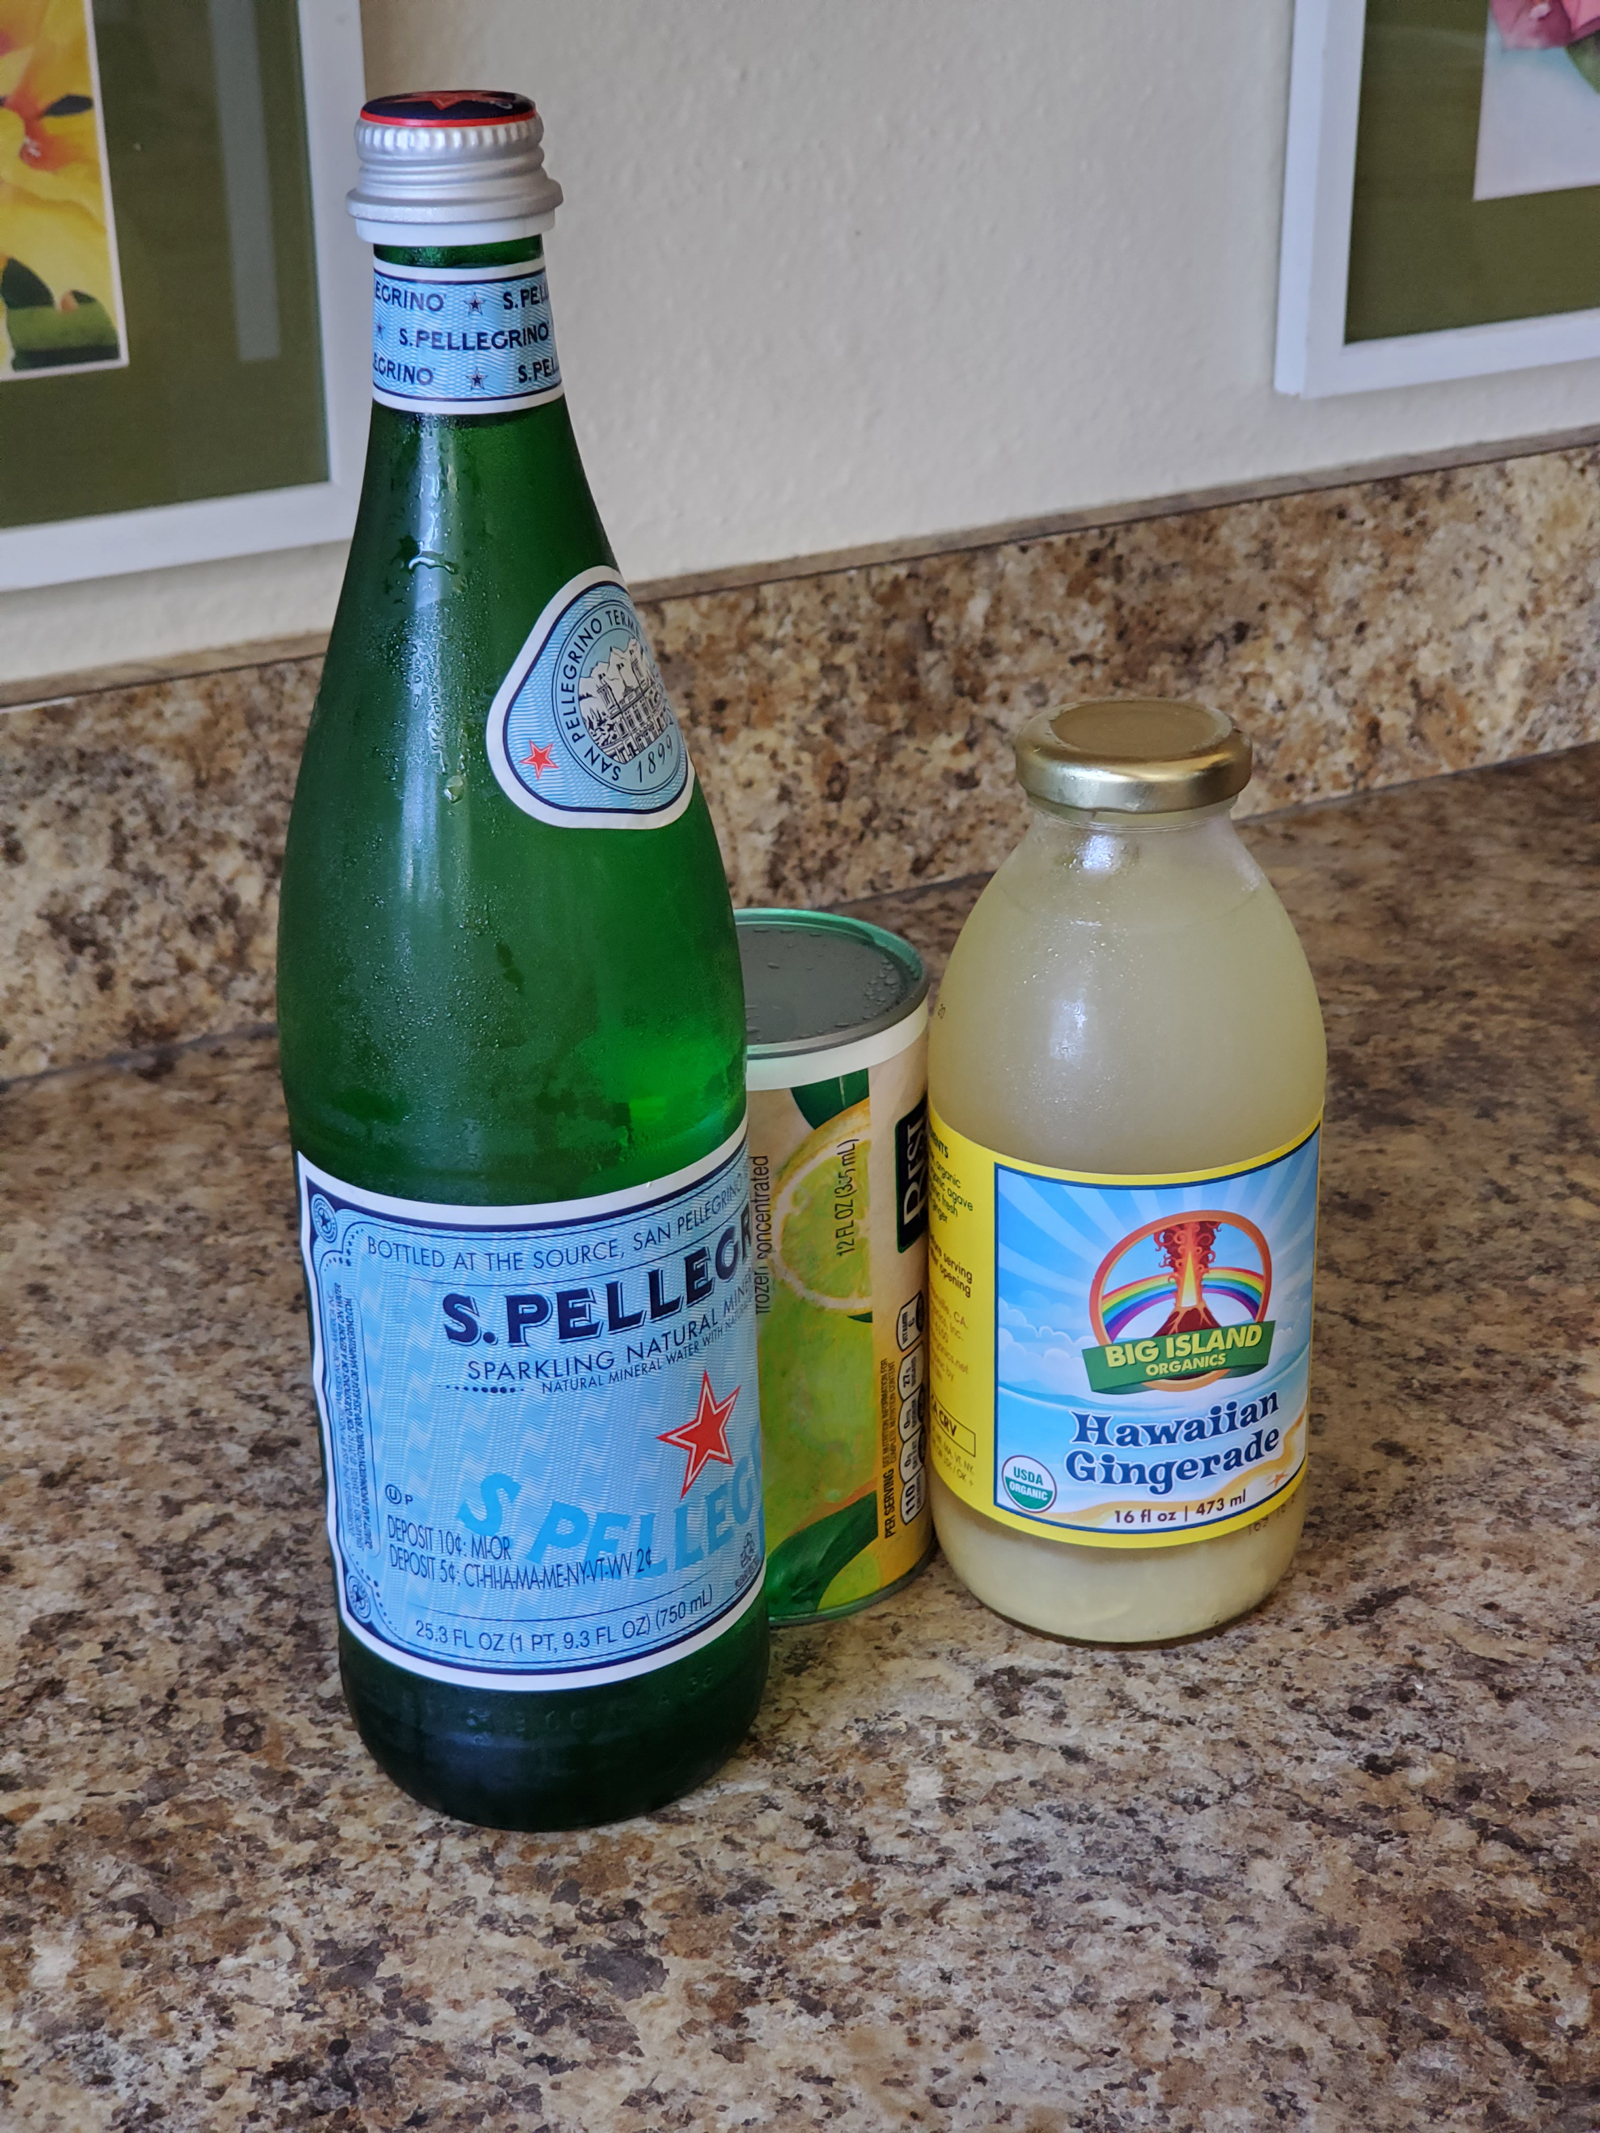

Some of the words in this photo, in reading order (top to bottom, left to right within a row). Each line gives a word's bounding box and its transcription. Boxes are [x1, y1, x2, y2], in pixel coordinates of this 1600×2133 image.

[399, 321, 550, 351] S.PELLEGRINO
[560, 616, 603, 745] PELLEGRINO
[582, 744, 622, 782] SAN
[636, 733, 674, 784] 1899
[836, 1138, 860, 1167] mL)
[750, 1154, 773, 1261] concentrated
[834, 1199, 854, 1220] OZ
[946, 1187, 974, 1212] agave
[367, 1235, 445, 1268] BOTTLED
[453, 1251, 477, 1271] AT
[484, 1251, 525, 1272] THE
[533, 1238, 625, 1270] SOURCE,
[633, 1221, 672, 1252] SAN
[835, 1220, 854, 1239] FL
[836, 1238, 855, 1257] 12
[939, 1263, 971, 1299] opening
[942, 1252, 973, 1285] serving
[467, 1350, 615, 1381] SPARKLING
[627, 1307, 719, 1364] NATURAL
[1104, 1339, 1160, 1369] BIG
[1165, 1323, 1264, 1360] ISLAND
[541, 1374, 604, 1395] NATURAL
[608, 1357, 662, 1385] MINERAL
[665, 1341, 699, 1365] WATER
[1145, 1352, 1227, 1377] ORGANICS
[938, 1408, 958, 1437] CRV
[1069, 1390, 1280, 1449] Hawaiian
[1013, 1465, 1044, 1487] USDA
[1064, 1427, 1280, 1496] Gingerade
[882, 1468, 896, 1517] SERVING
[905, 1484, 916, 1516] 110
[1009, 1480, 1049, 1501] ORGANIC
[1114, 1509, 1135, 1525] 16
[1140, 1508, 1152, 1523] fl
[1157, 1509, 1177, 1522] oz
[1195, 1497, 1225, 1516] 473
[1229, 1488, 1247, 1508] ml
[386, 1514, 434, 1552] DEPOSIT
[438, 1528, 468, 1558] 10¢:
[884, 1514, 897, 1540] PER
[388, 1543, 436, 1581] DEPOSIT
[439, 1558, 461, 1586] 5¢:
[636, 1545, 653, 1573] 2¢
[415, 1619, 449, 1644] 25.3
[453, 1629, 475, 1649] FL
[478, 1632, 505, 1652] OZ
[509, 1631, 523, 1654] (1
[530, 1633, 559, 1654] PT,
[563, 1630, 591, 1650] 9.3
[596, 1626, 618, 1647] FL
[622, 1613, 652, 1640] OZ)
[655, 1602, 687, 1632] (750
[689, 1583, 714, 1614] mL)
